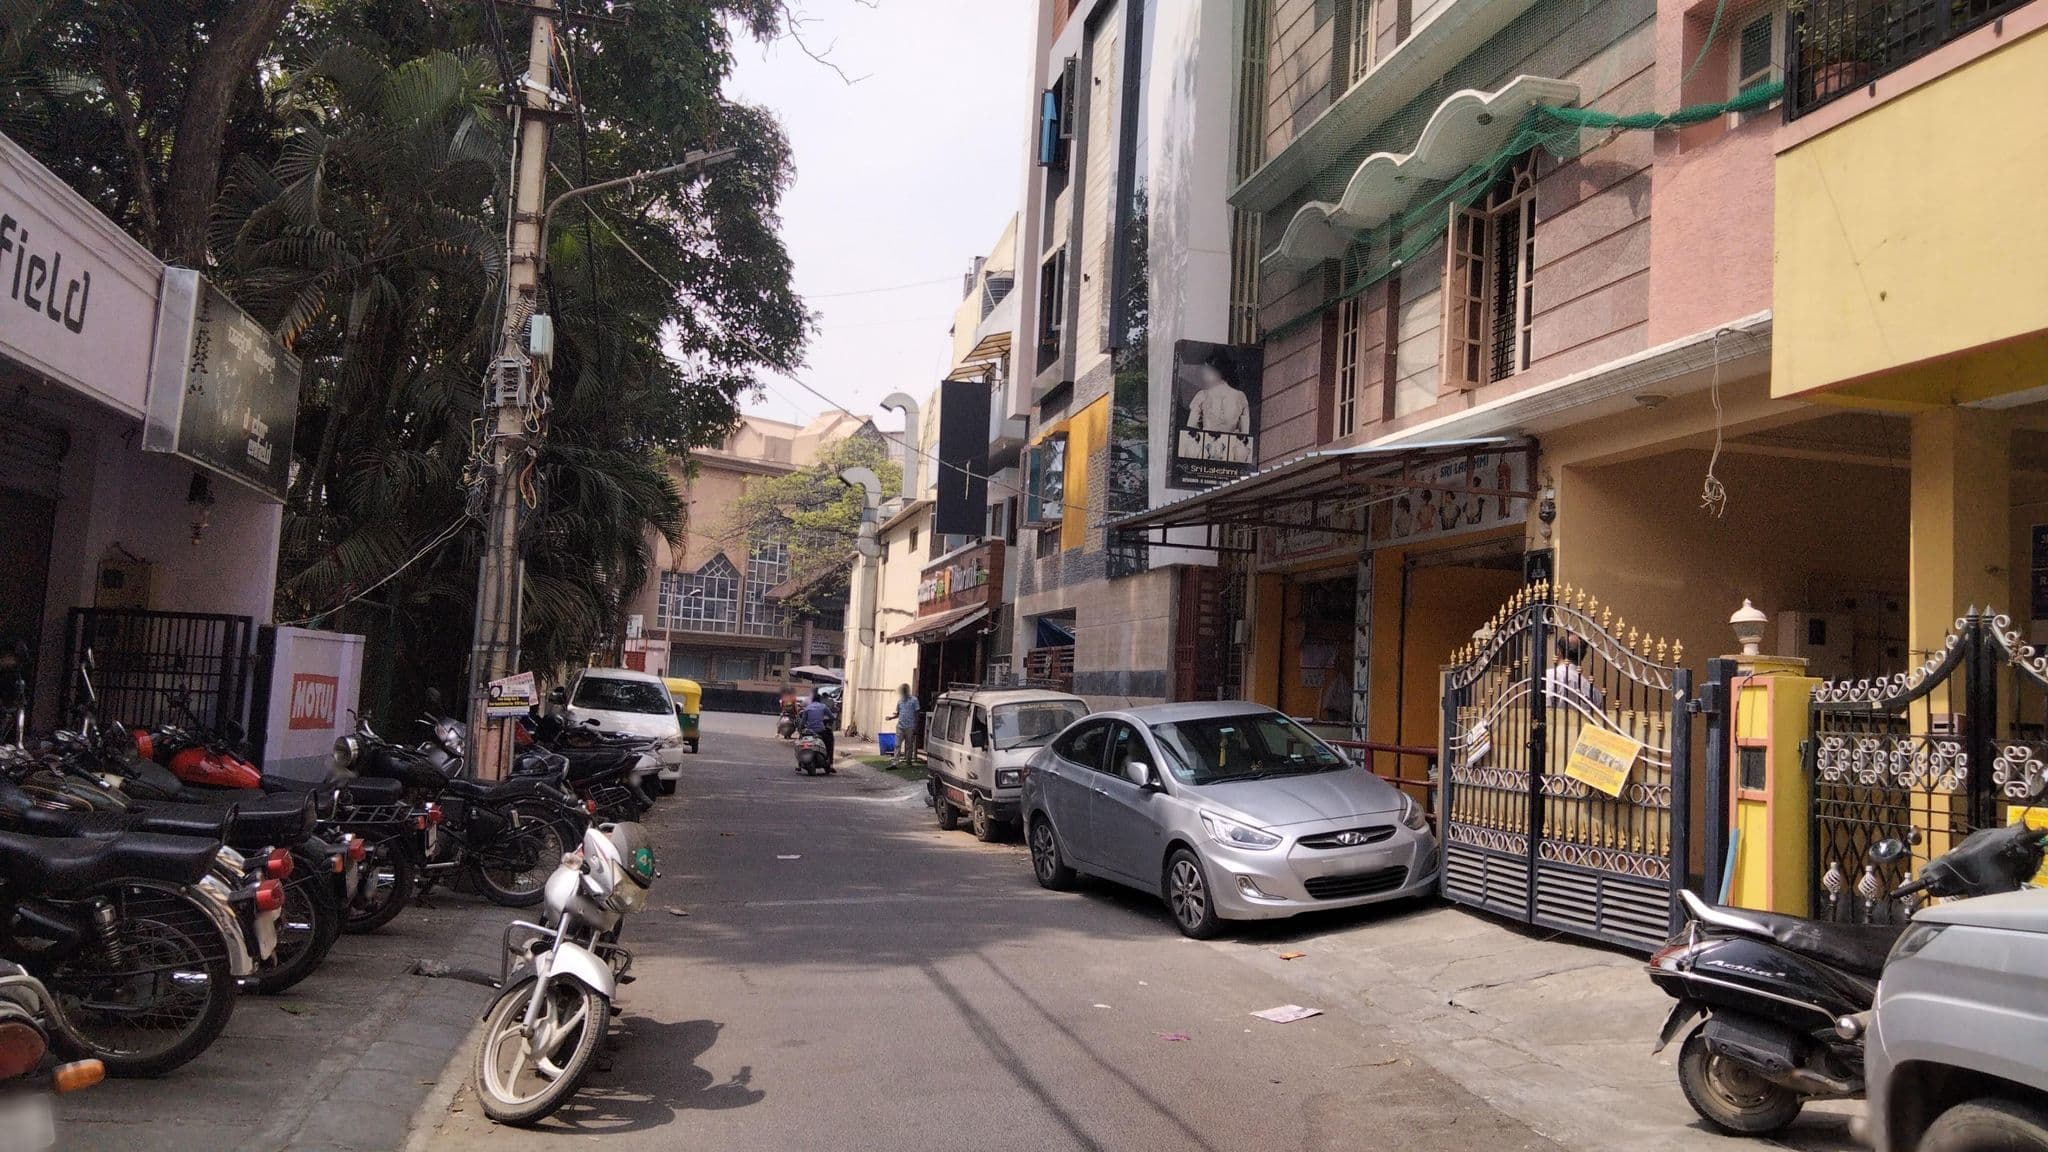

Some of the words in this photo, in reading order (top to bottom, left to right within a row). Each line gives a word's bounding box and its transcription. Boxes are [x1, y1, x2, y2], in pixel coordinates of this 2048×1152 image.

[1190, 464, 1203, 473] Sri
[1203, 466, 1238, 476] Lakshmi
[291, 679, 335, 724] MOTUL
